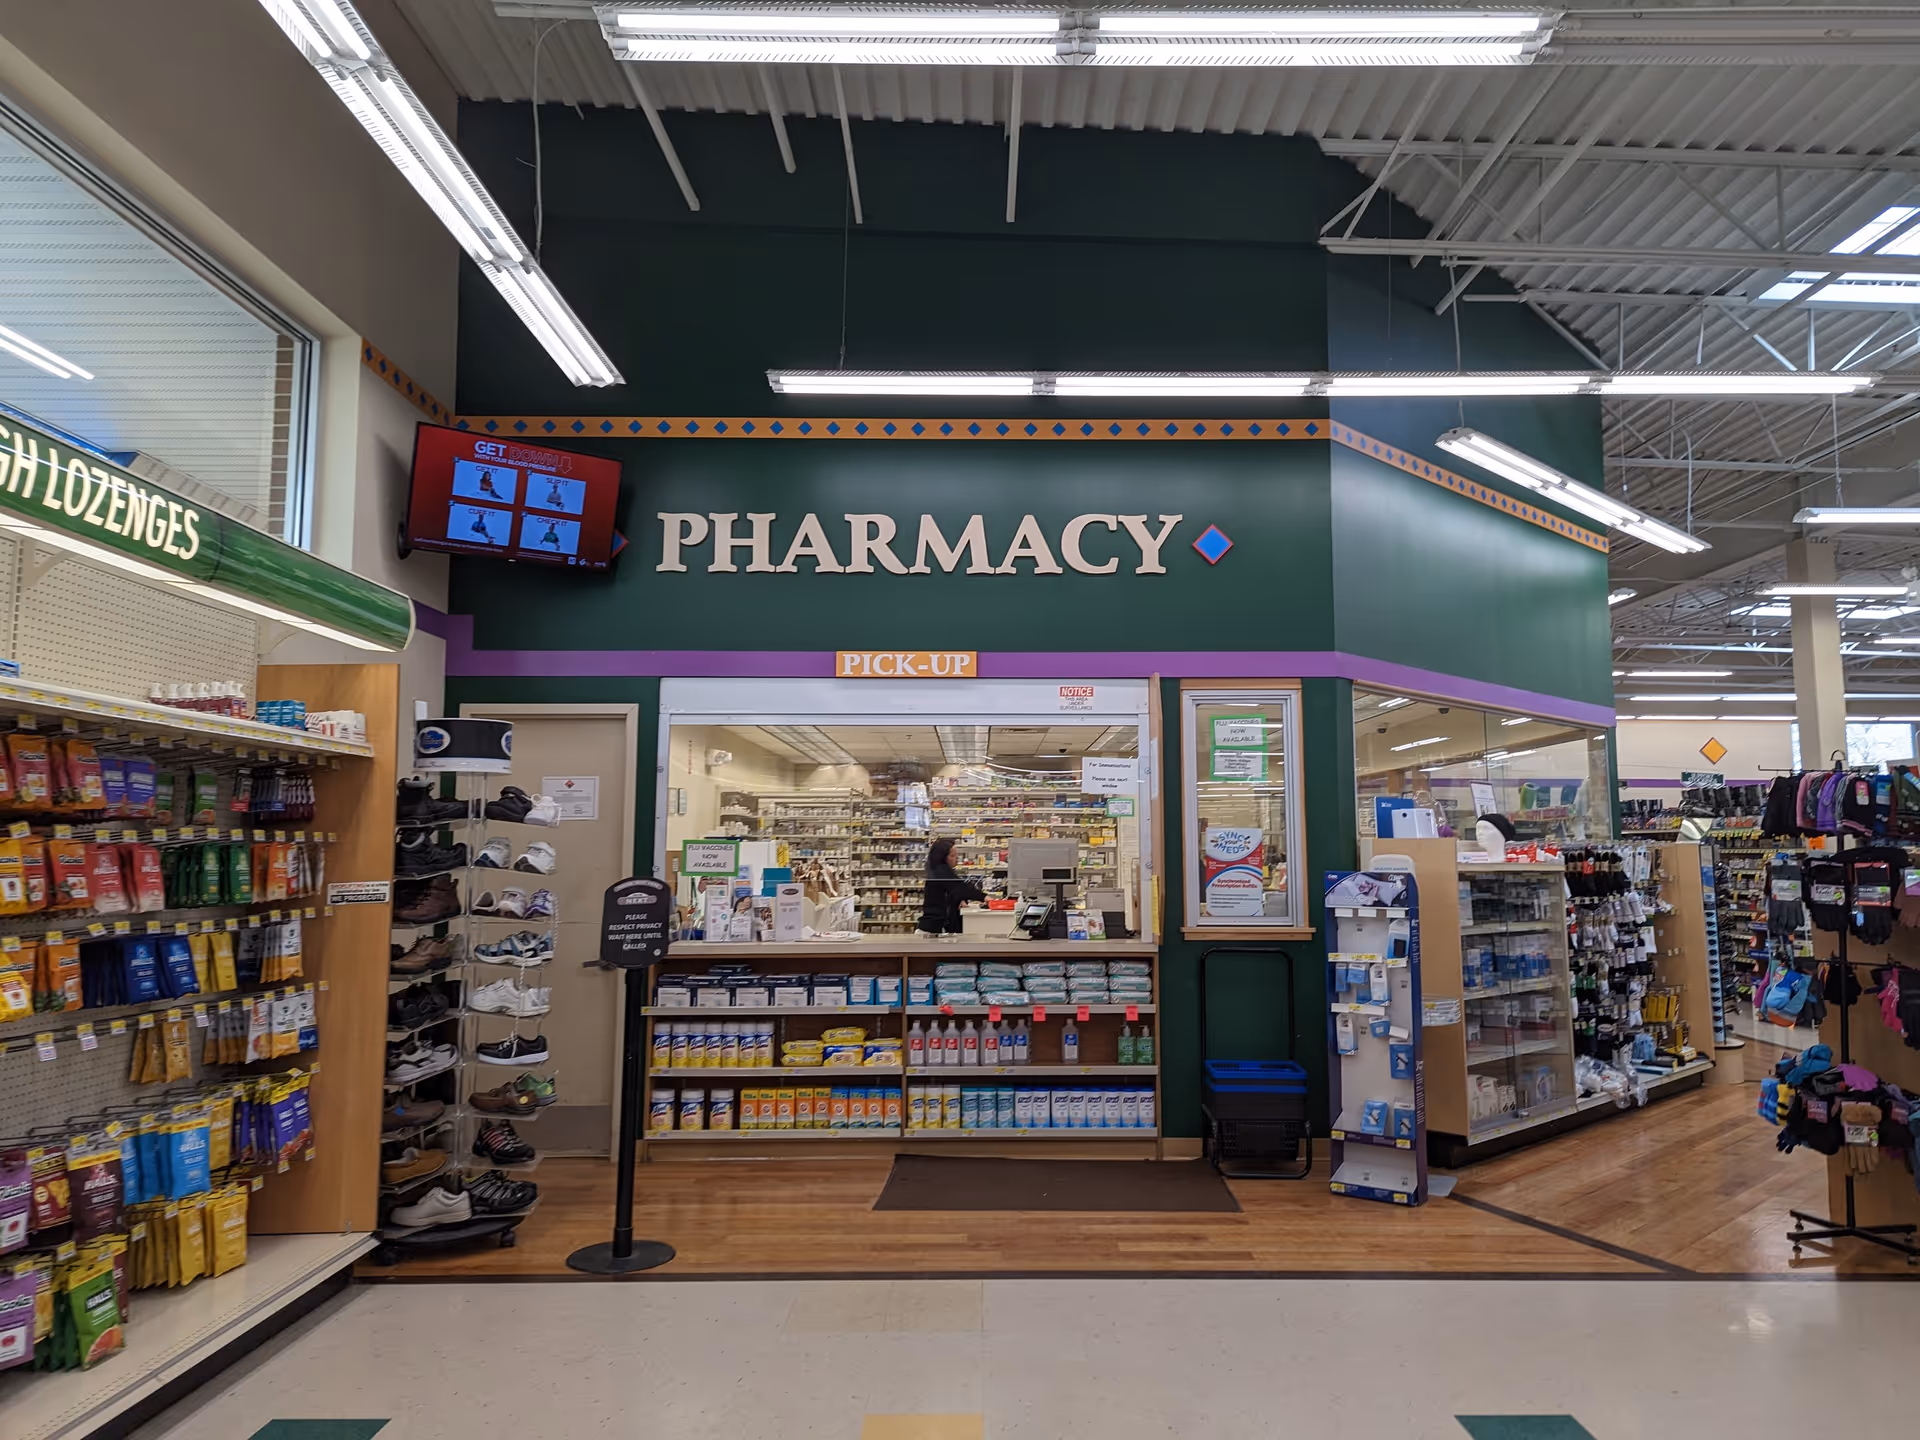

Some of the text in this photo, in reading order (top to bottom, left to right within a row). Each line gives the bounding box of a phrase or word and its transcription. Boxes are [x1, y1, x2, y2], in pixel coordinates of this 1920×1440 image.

[474, 440, 560, 467] GET DOWN
[474, 453, 557, 472] WITH YOUR BLOOD PRESSURE
[42, 447, 199, 560] LOZENGES
[656, 512, 1183, 576] PHARMACY
[842, 653, 971, 675] PICK-UP
[1061, 687, 1093, 697] NOTICE
[1219, 831, 1245, 842] SYNC
[1218, 843, 1245, 854] MEDS
[344, 893, 386, 901] PROSECUTE
[608, 922, 663, 931] RESPECT PRIVACY
[622, 943, 647, 951] CALLED
